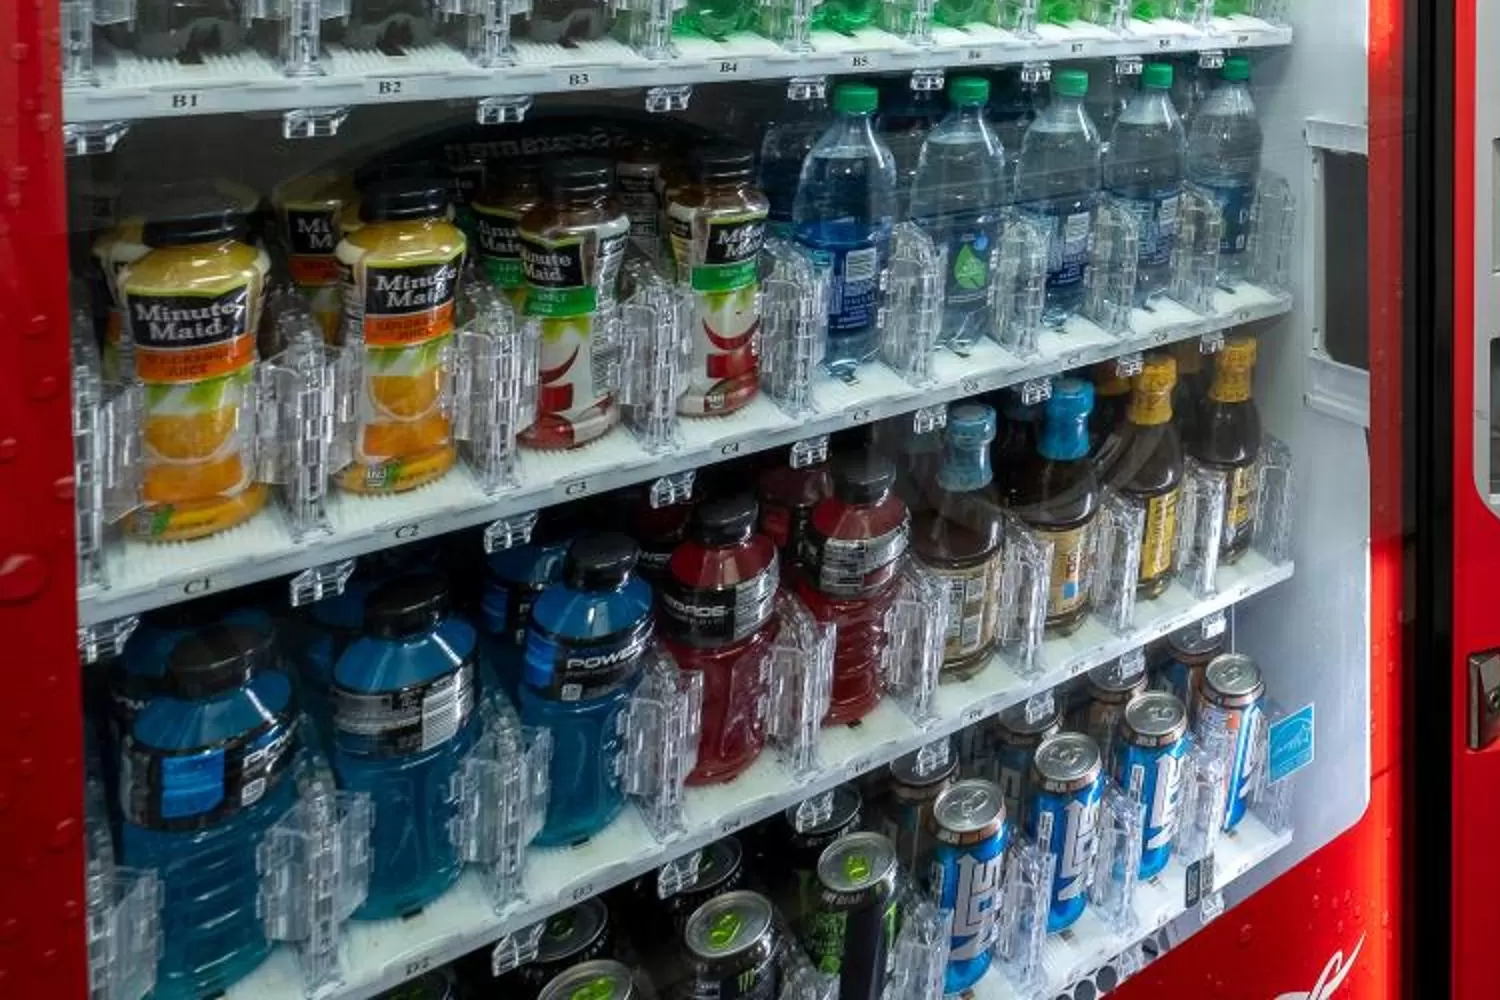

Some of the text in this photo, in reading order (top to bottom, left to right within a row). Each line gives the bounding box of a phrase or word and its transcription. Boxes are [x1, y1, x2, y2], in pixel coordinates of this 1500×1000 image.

[720, 62, 737, 73] B4
[852, 56, 869, 67] B5
[569, 73, 589, 86] B3
[379, 80, 401, 95] B2
[172, 94, 198, 108] B1
[375, 266, 456, 291] Minute
[134, 298, 240, 323] Minute
[148, 318, 228, 342] Maid
[721, 442, 739, 455] C4
[565, 481, 587, 495] C3
[395, 524, 419, 538] C2
[184, 577, 209, 594] C1
